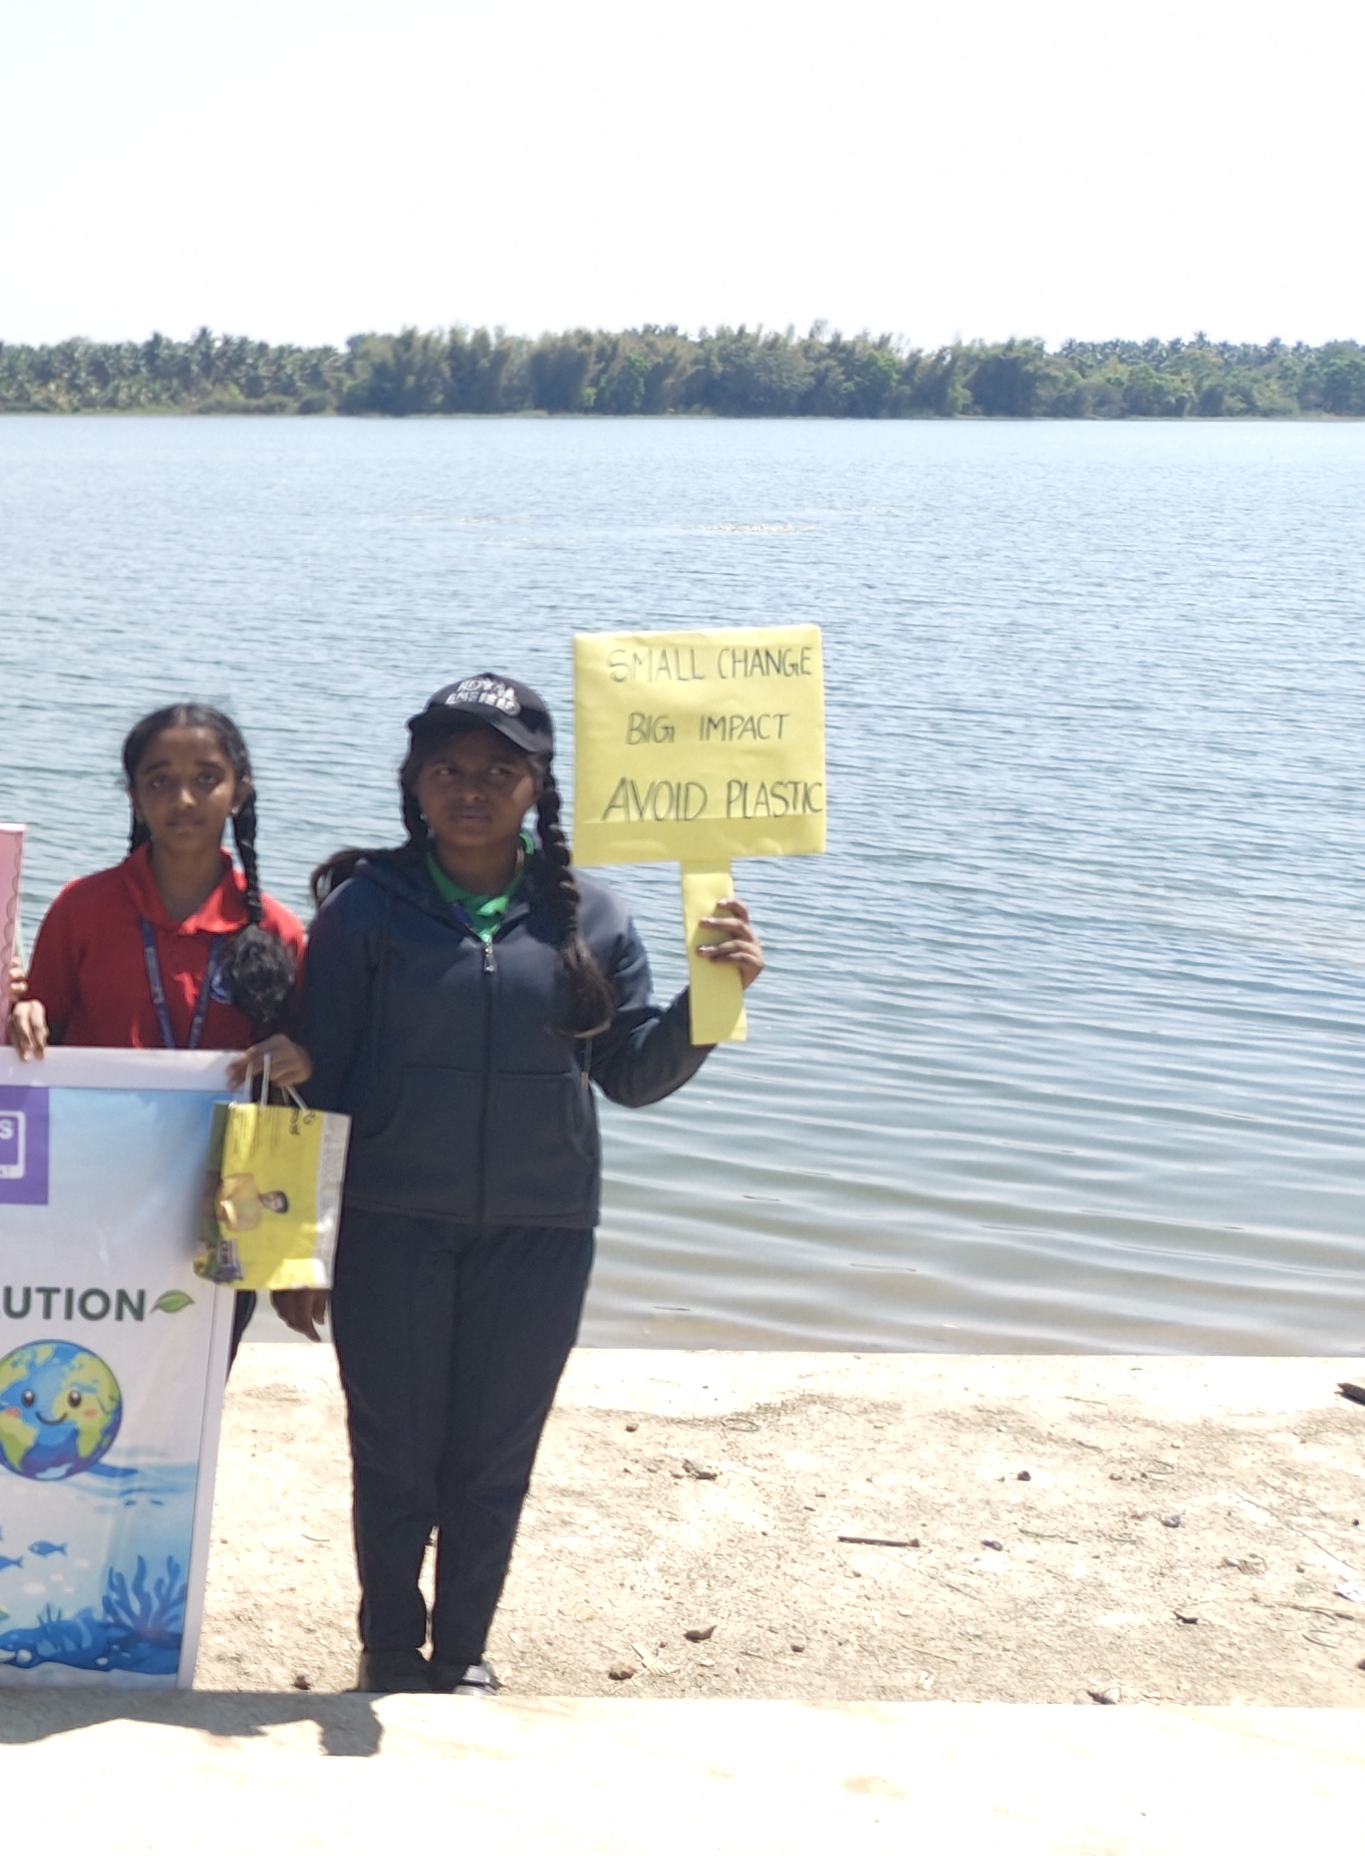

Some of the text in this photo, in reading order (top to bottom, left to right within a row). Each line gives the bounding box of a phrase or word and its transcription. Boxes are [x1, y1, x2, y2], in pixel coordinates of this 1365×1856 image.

[608, 646, 813, 683] SMALL CHANGE
[625, 712, 792, 745] BIG IMPACT
[600, 776, 823, 823] AVOID PLASTIC
